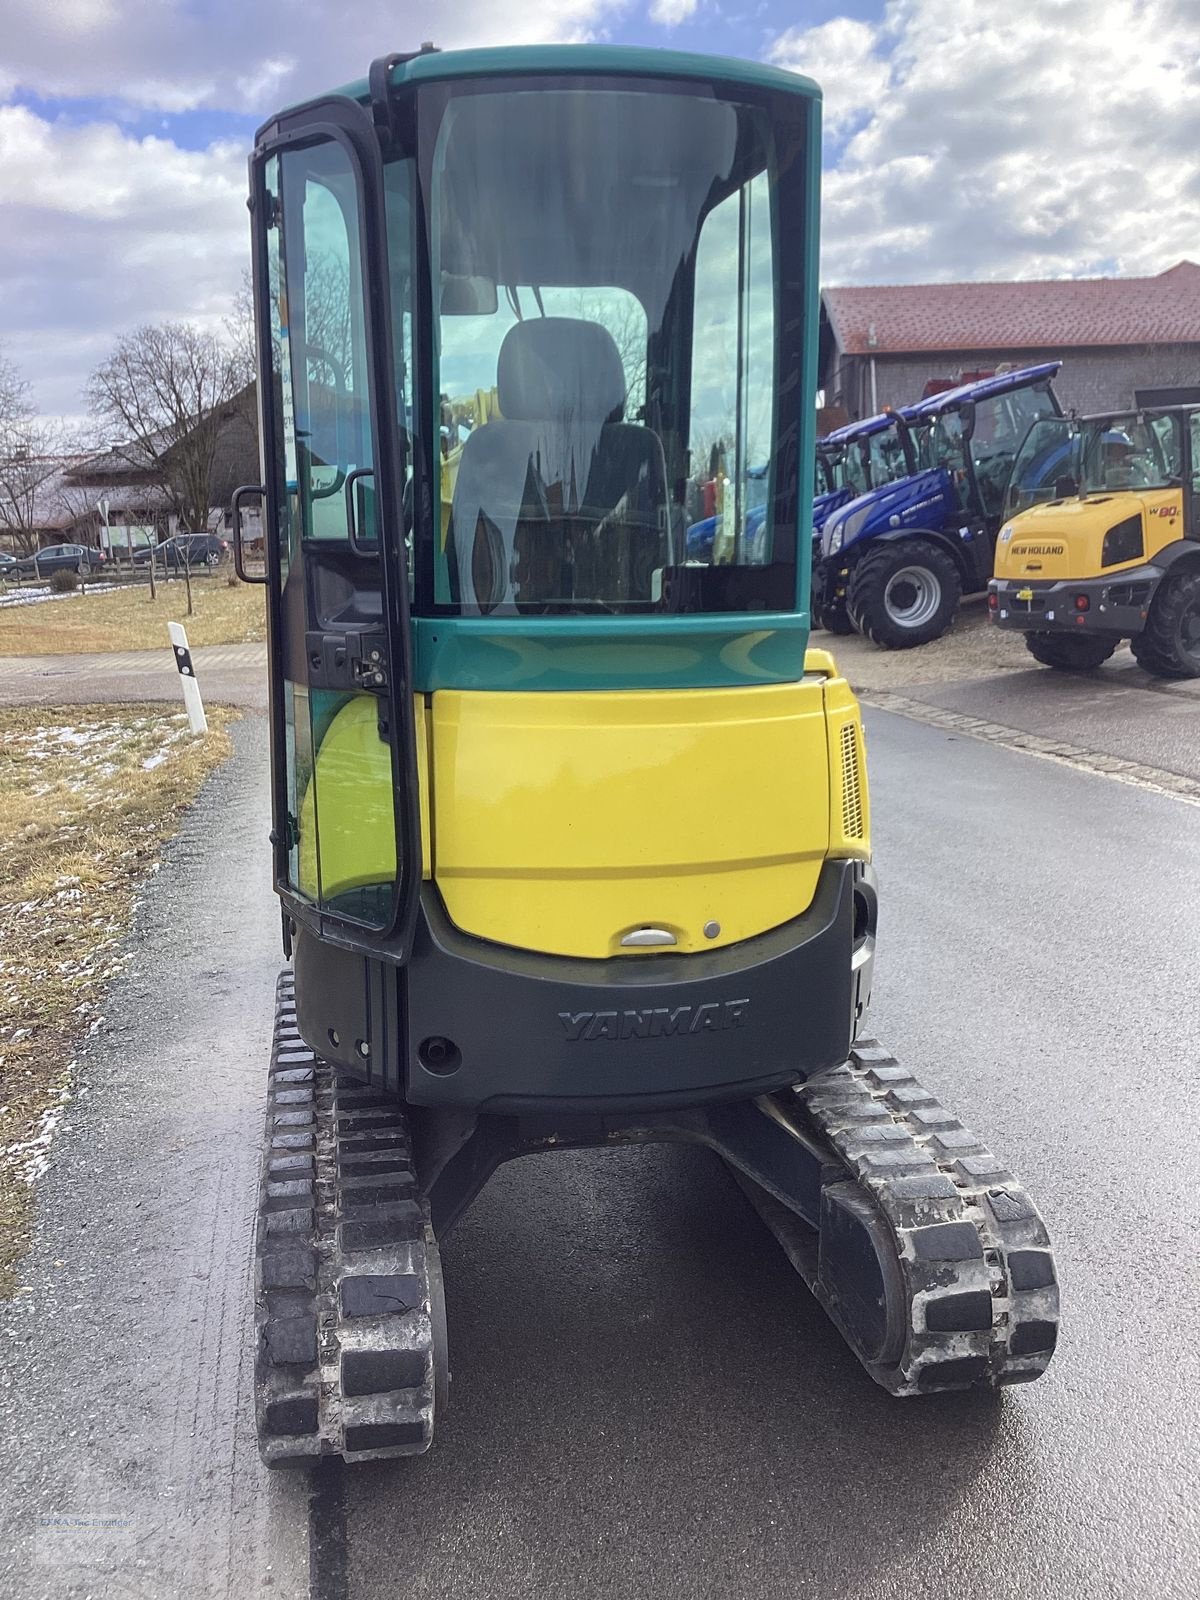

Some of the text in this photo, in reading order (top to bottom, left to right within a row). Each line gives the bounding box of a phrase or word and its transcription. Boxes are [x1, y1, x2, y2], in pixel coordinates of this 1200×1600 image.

[1011, 545, 1064, 555] NEW HOLLAND
[557, 998, 750, 1041] YANMAR
